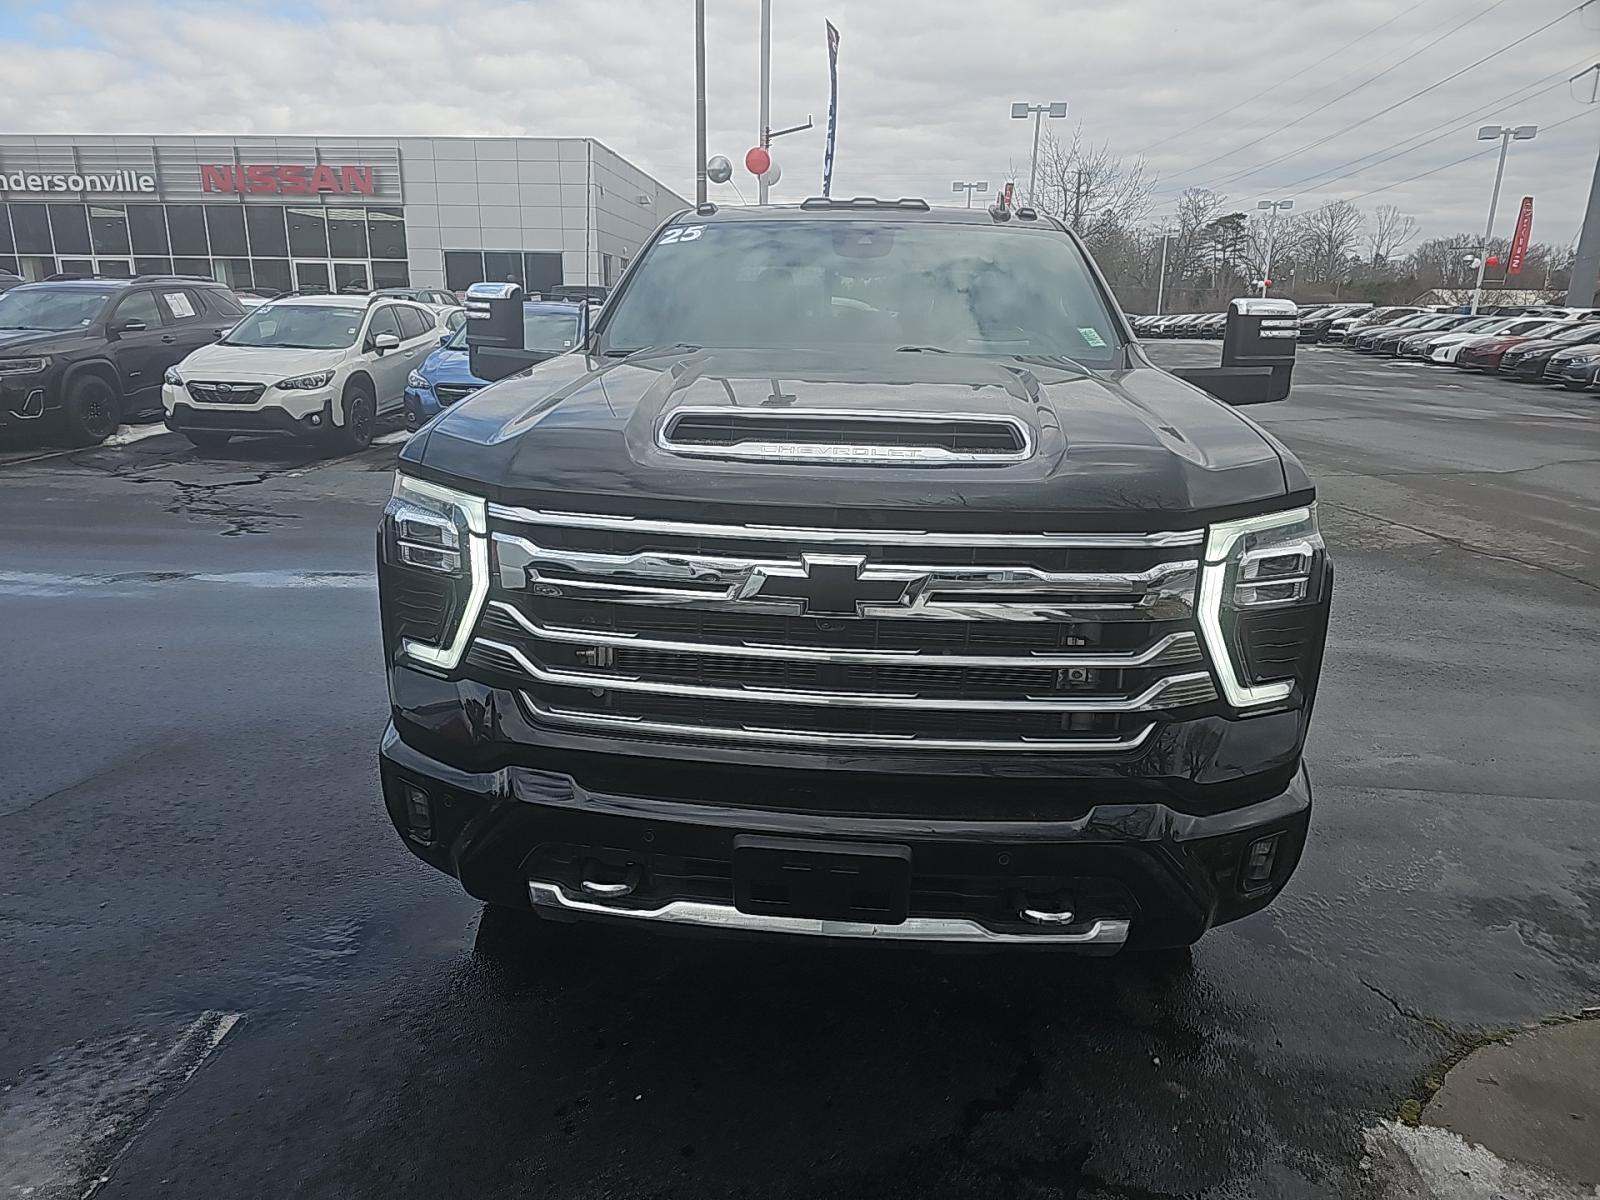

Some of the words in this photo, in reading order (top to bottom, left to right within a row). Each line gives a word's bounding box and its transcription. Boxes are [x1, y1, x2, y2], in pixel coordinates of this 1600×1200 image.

[201, 165, 374, 193] NISSAN
[658, 224, 703, 245] 25
[761, 444, 923, 458] CHEVROLET
